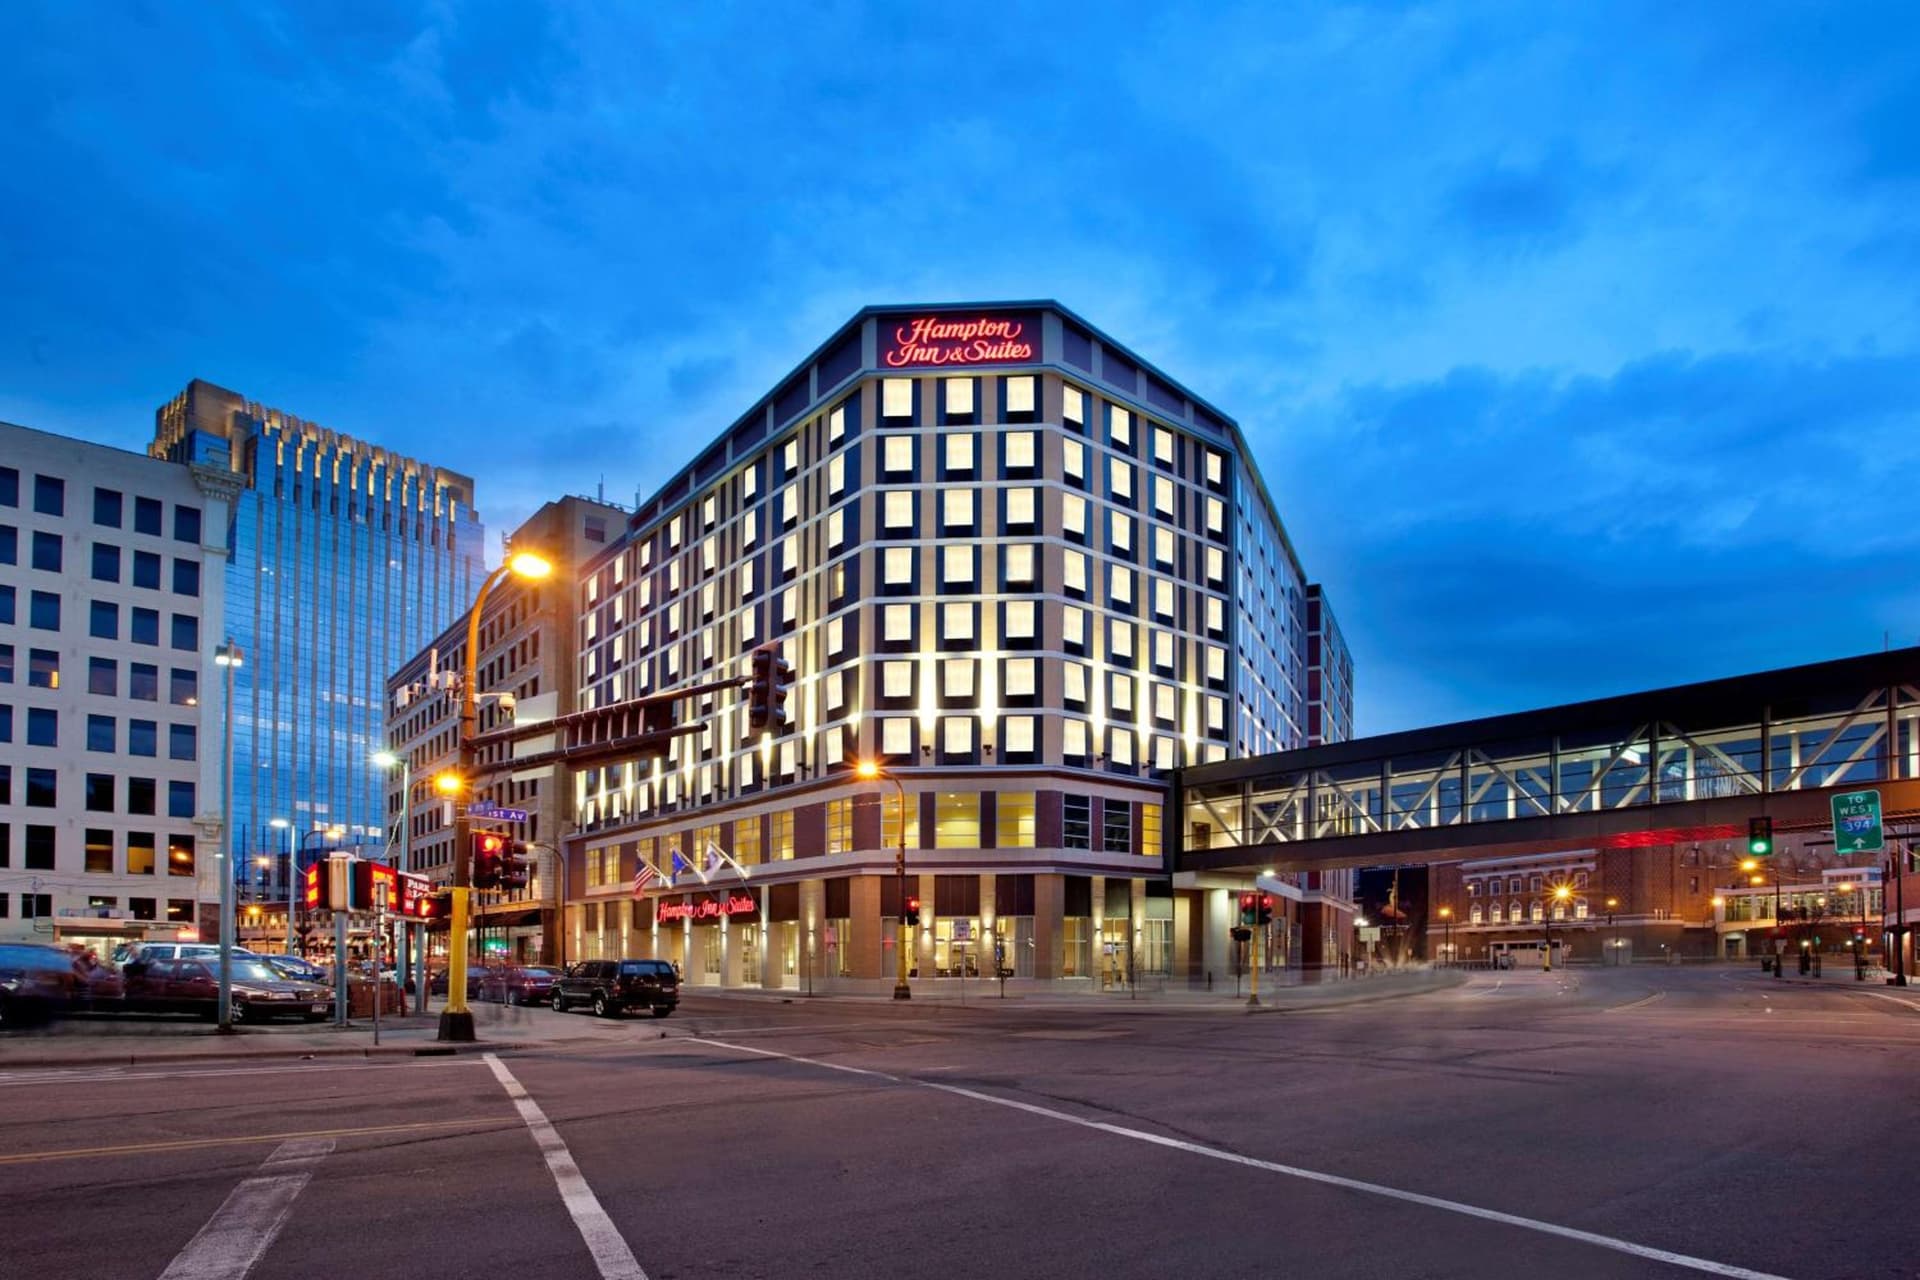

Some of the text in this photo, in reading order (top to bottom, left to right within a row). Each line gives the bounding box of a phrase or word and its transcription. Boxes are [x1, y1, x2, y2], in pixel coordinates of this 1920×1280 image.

[896, 317, 1022, 345] Hampton
[887, 340, 1032, 366] Inn & Suites
[1839, 803, 1874, 815] WEST
[1847, 795, 1864, 805] TO
[1846, 820, 1871, 832] 394
[657, 901, 697, 922] Hampton
[698, 899, 721, 918] Inn
[727, 896, 754, 914] Suites
